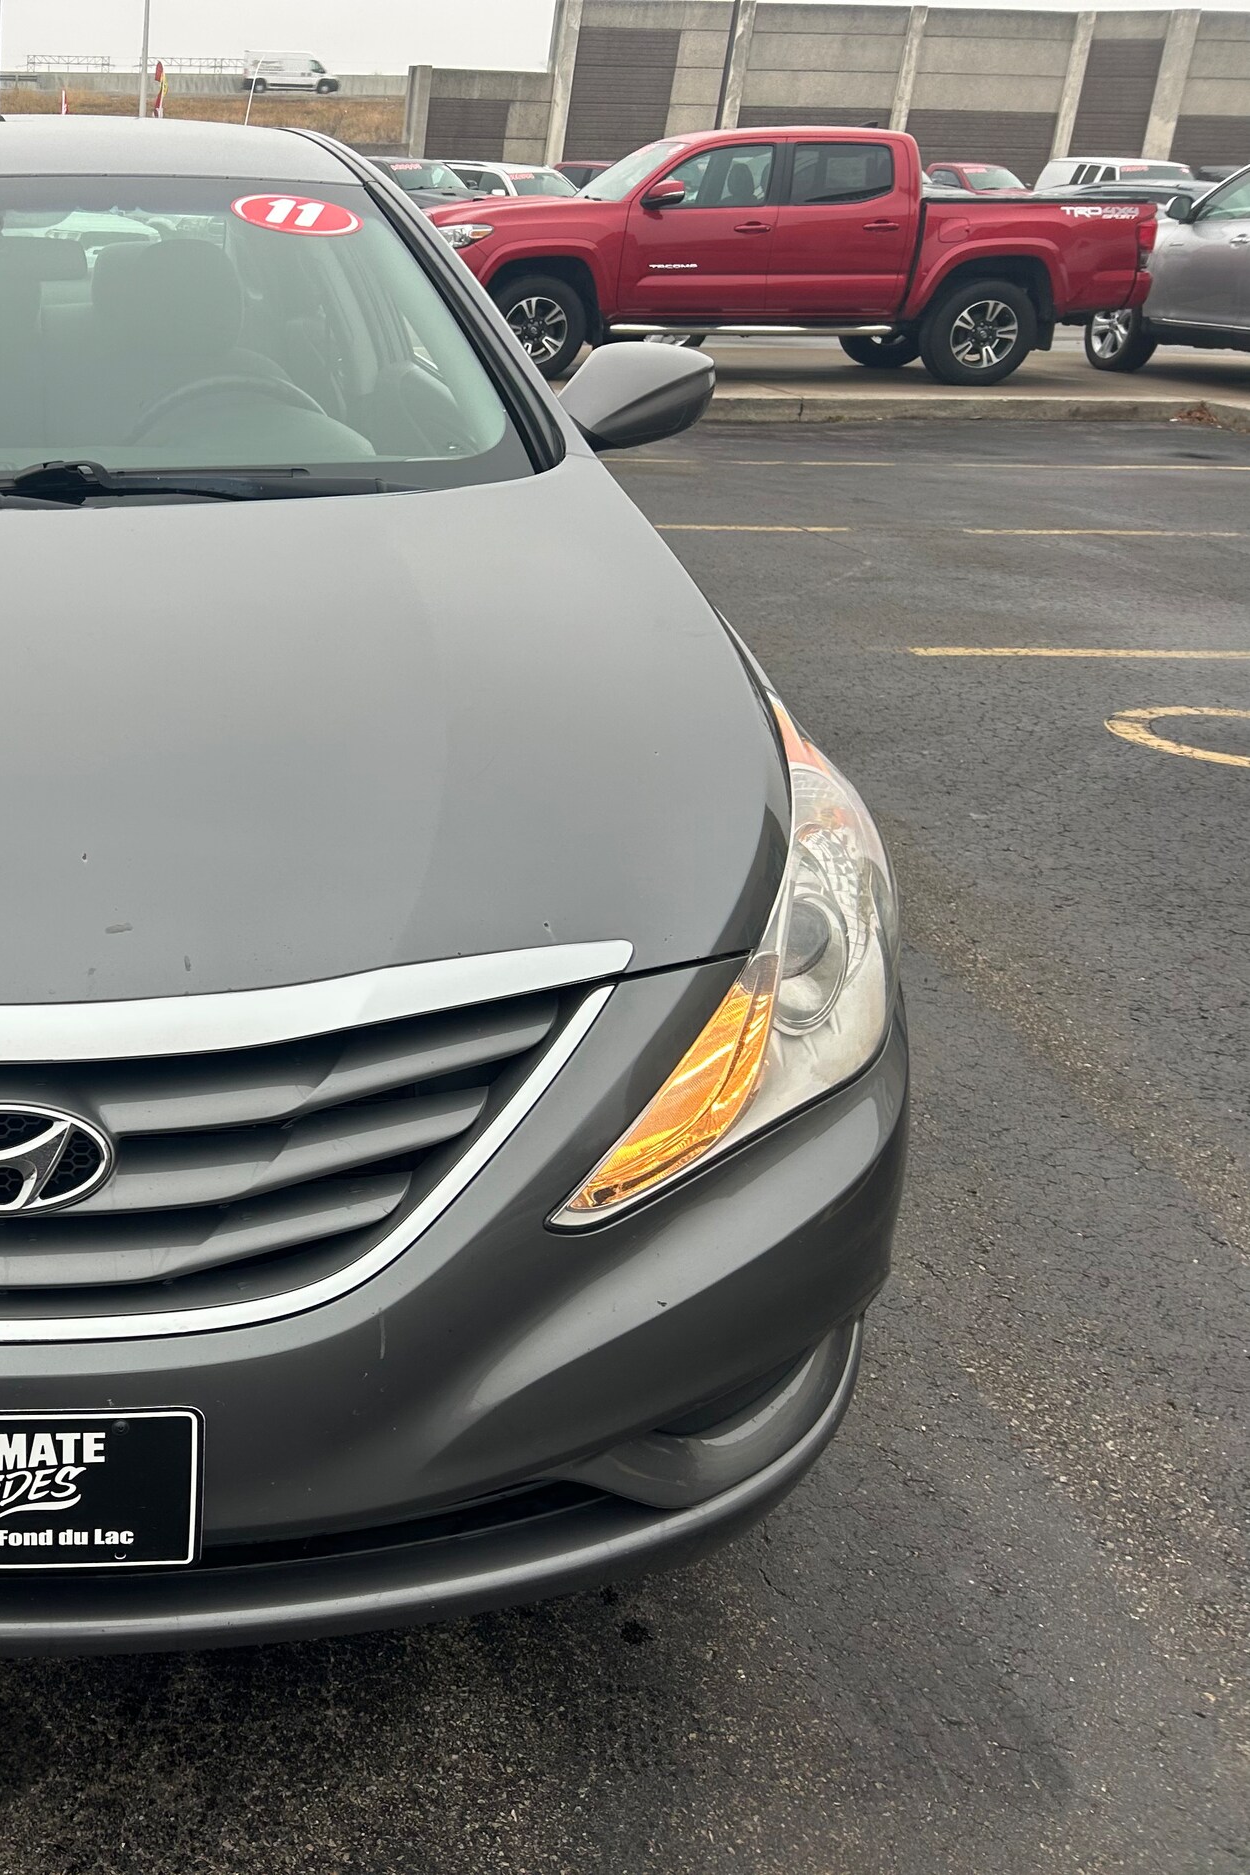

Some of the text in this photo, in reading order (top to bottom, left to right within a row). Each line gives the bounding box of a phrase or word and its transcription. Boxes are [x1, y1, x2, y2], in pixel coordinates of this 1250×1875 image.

[265, 198, 326, 227] 11
[1060, 206, 1102, 218] TRD
[58, 1528, 89, 1546] du
[93, 1527, 135, 1546] Lac
